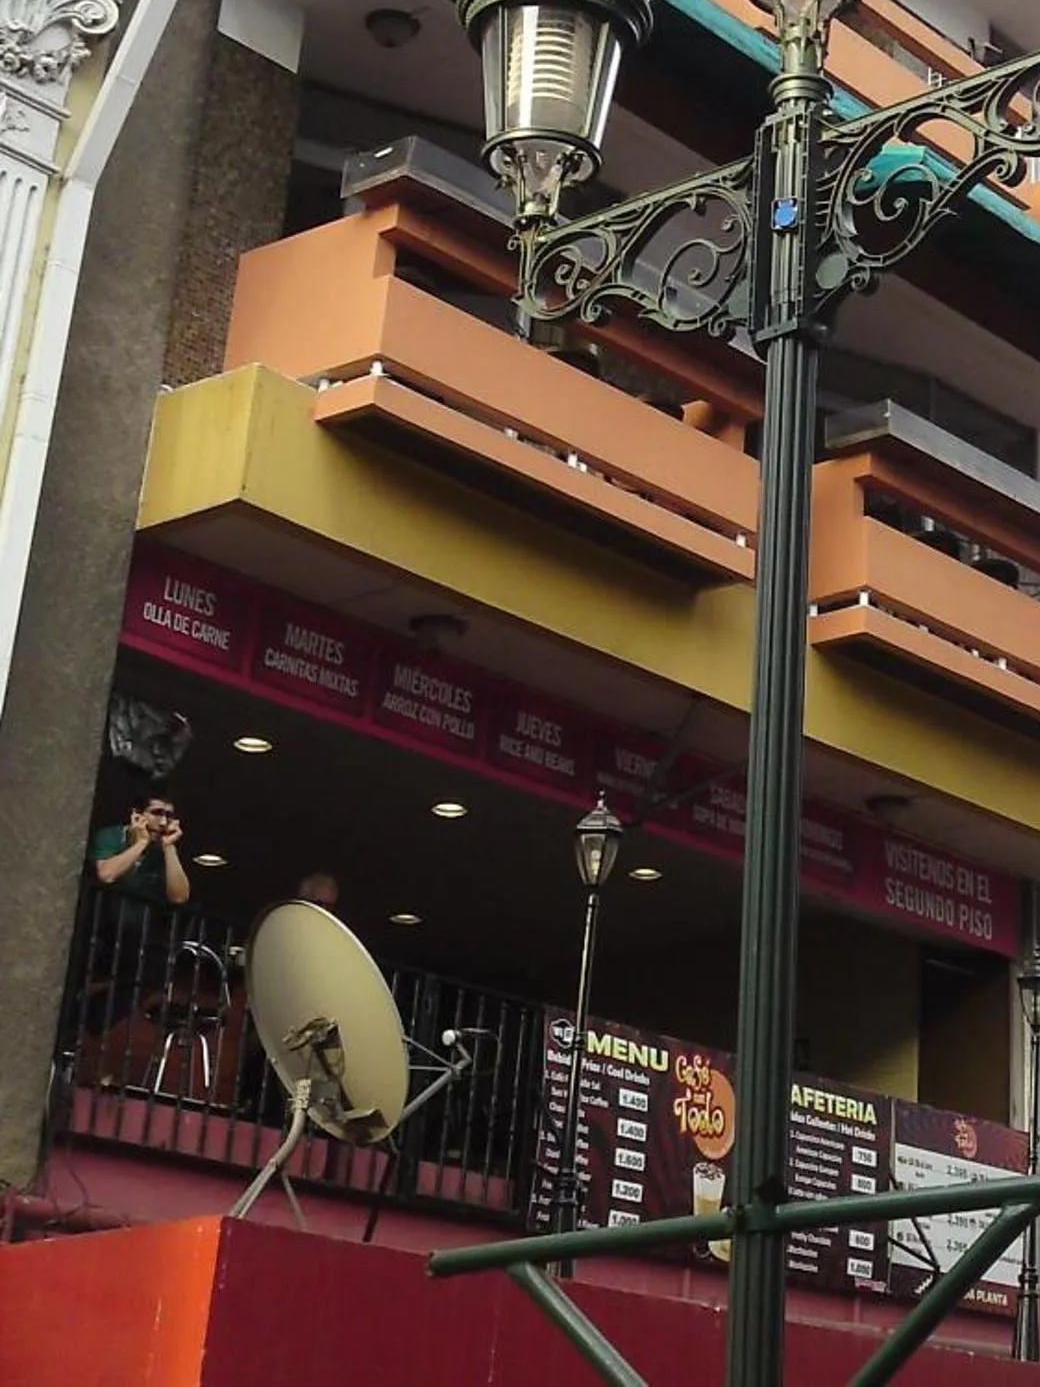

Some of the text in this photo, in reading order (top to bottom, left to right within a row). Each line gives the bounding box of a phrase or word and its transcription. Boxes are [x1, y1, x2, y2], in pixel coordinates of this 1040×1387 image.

[164, 575, 217, 617] LUNES
[143, 602, 232, 651] OLLA DE CARNE
[284, 622, 344, 665] MARTES
[264, 647, 319, 685] CARNITAS
[381, 692, 475, 741] ARROZ CON POLLO
[515, 710, 563, 748] JUEVES
[956, 867, 976, 898] EN
[976, 873, 993, 905] EL
[884, 876, 993, 942] SEGUNDO PISO
[586, 1029, 669, 1072] MENU
[676, 1054, 710, 1091] Café
[674, 1087, 725, 1135] Todo
[791, 1083, 878, 1126] AFETERIA
[976, 1289, 1008, 1307] PLANTA
